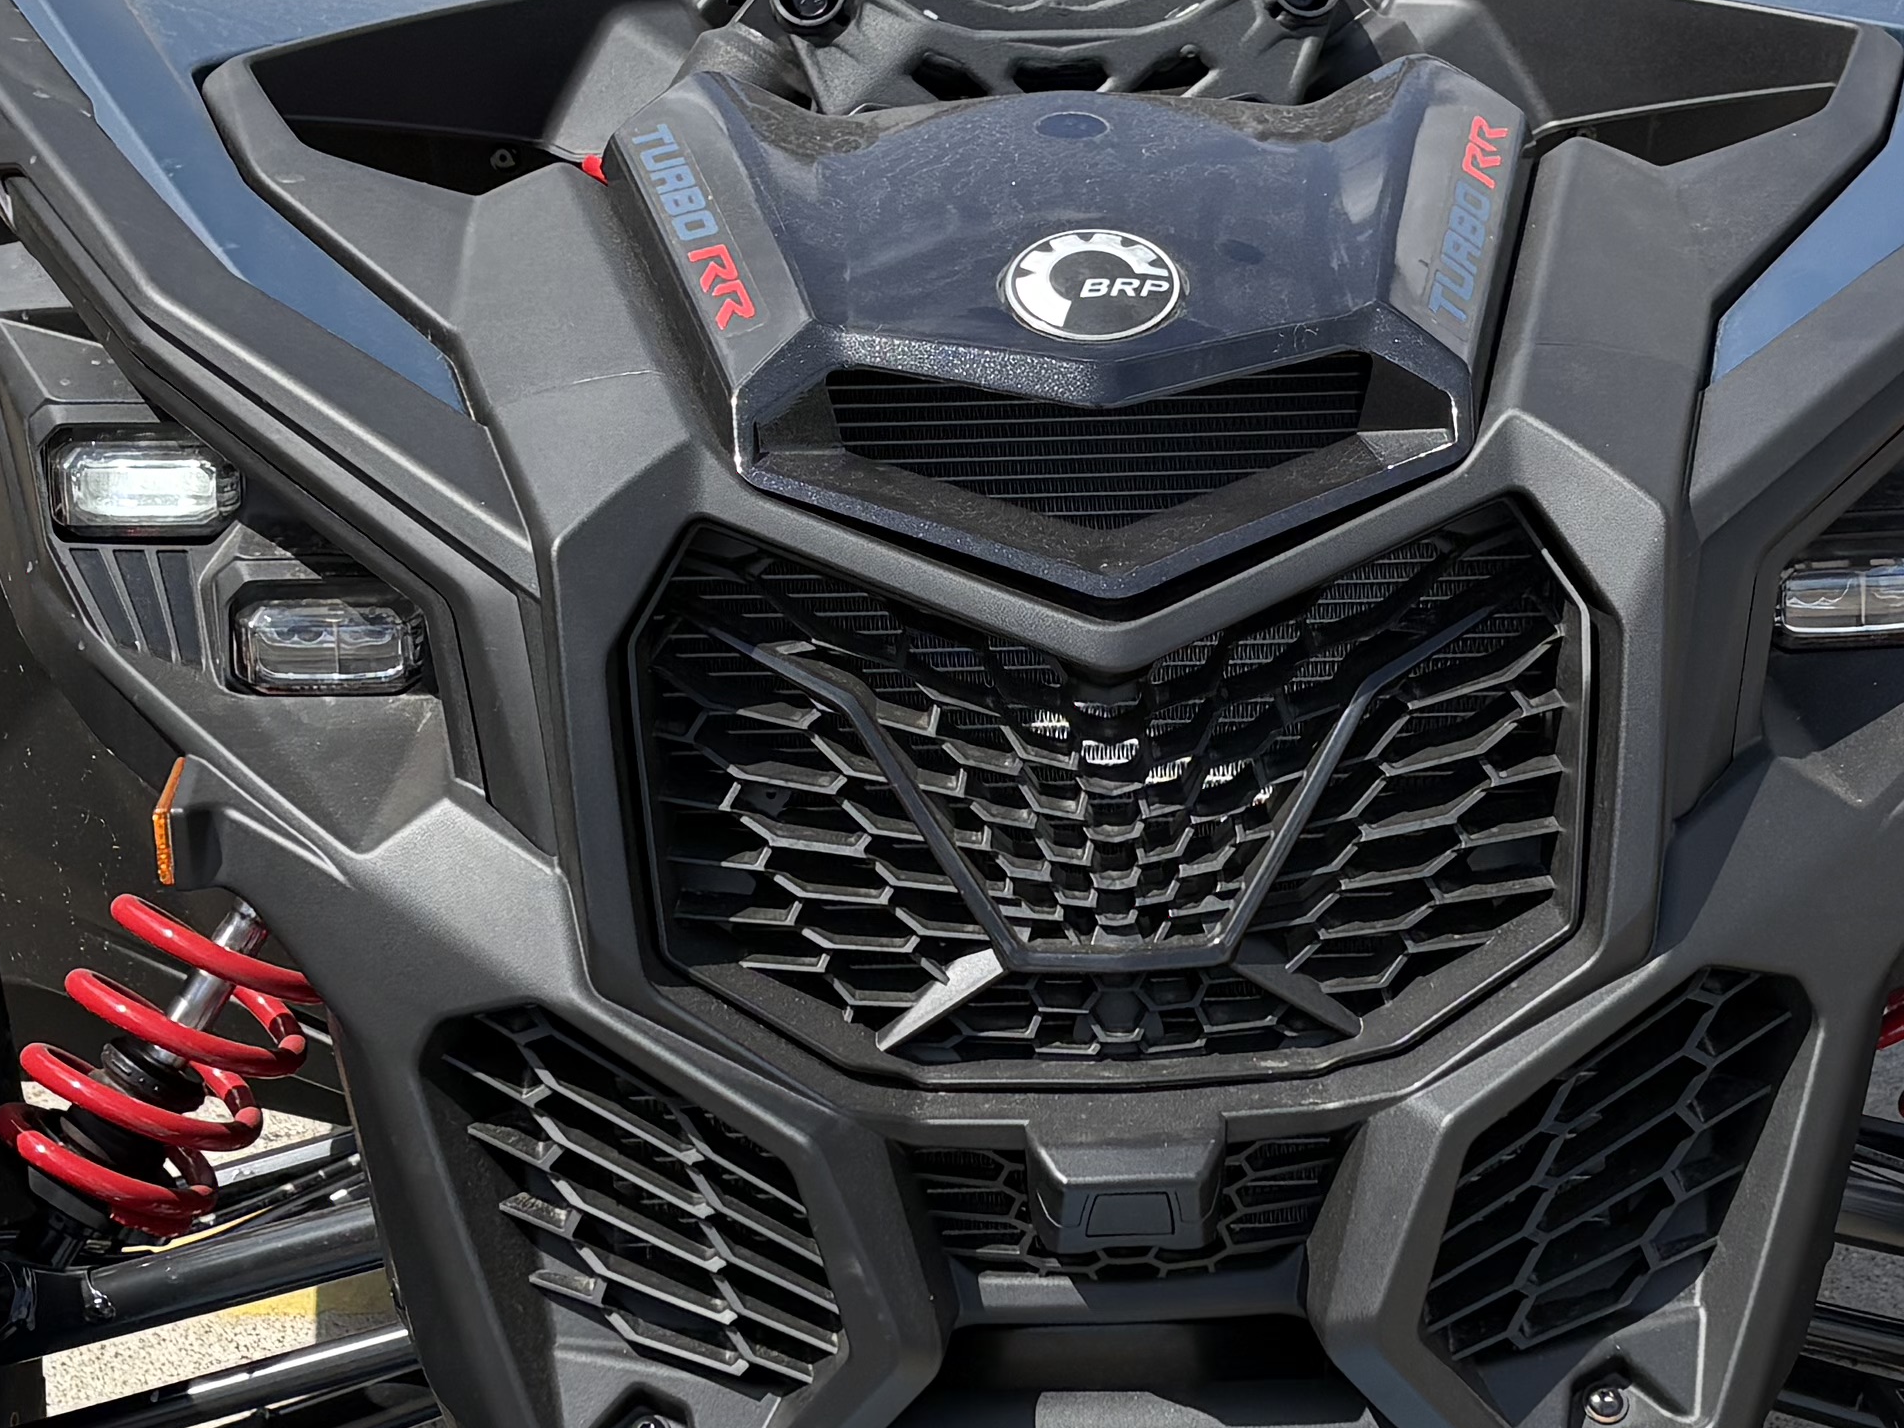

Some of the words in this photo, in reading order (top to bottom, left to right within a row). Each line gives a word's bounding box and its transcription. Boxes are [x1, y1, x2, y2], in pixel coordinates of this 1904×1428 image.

[632, 123, 720, 242] TURBO
[687, 243, 756, 331] RR
[1079, 277, 1170, 298] BRP
[1428, 179, 1491, 322] TURBO
[1462, 115, 1509, 189] RR
